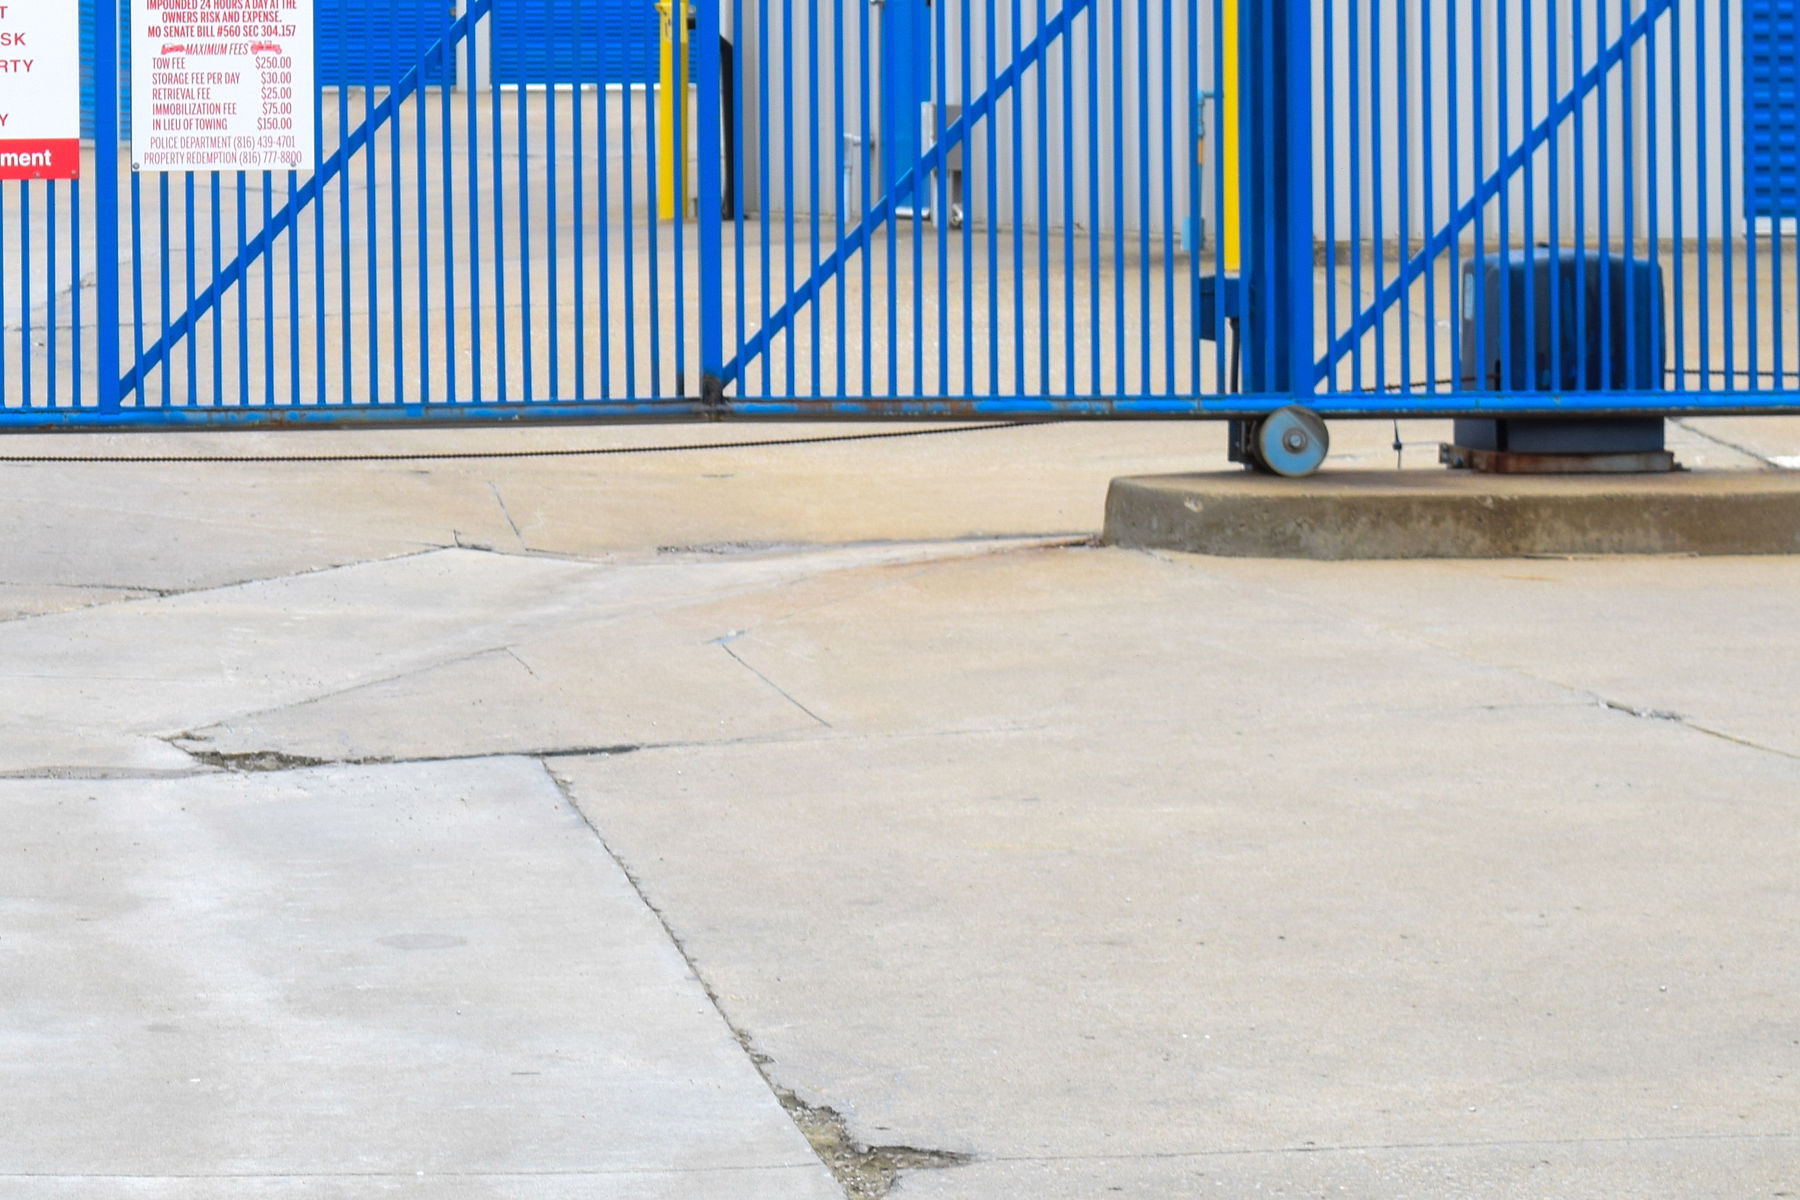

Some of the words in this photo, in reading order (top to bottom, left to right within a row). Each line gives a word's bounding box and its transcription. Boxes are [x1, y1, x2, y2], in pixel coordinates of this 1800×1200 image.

[162, 12, 198, 23] OWNERS
[200, 12, 221, 22] RISK
[222, 11, 240, 22] AND
[242, 11, 282, 22] EXPENSE.
[148, 26, 161, 37] MO
[164, 26, 195, 37] SENATE
[197, 26, 215, 37] BILL
[217, 25, 240, 37] #560
[243, 25, 258, 37] SEC
[261, 25, 296, 37] 304.157
[186, 44, 226, 55] MAXIMUM
[229, 43, 248, 55] FEES
[152, 58, 170, 69] TOW
[172, 57, 186, 69] FEE
[255, 56, 291, 69] $250.00
[152, 72, 189, 85] STORAGE
[191, 73, 205, 84] FEE
[207, 72, 222, 84] PER
[225, 72, 240, 84] DAY
[261, 71, 291, 85] $30.00
[152, 88, 195, 100] RETRIEVAL
[197, 88, 211, 100] FEE
[261, 87, 292, 100] $25.00
[152, 103, 221, 115] IMMOBILIZATION
[223, 103, 237, 115] FEE
[263, 102, 292, 115] $75.00
[152, 118, 162, 130] IN
[164, 118, 181, 130] LIEU
[183, 118, 194, 130] OF
[195, 118, 227, 130] TOWING
[257, 117, 292, 130] $150.00
[150, 136, 177, 149] POLICE
[180, 136, 231, 148] DEPARTMENT
[233, 135, 255, 151] (816)
[257, 135, 295, 148] 439-4701
[144, 152, 184, 164] PROPERTY
[187, 152, 237, 164] REDEMPTION
[239, 151, 261, 166] (816)
[263, 151, 302, 164] 777-8800
